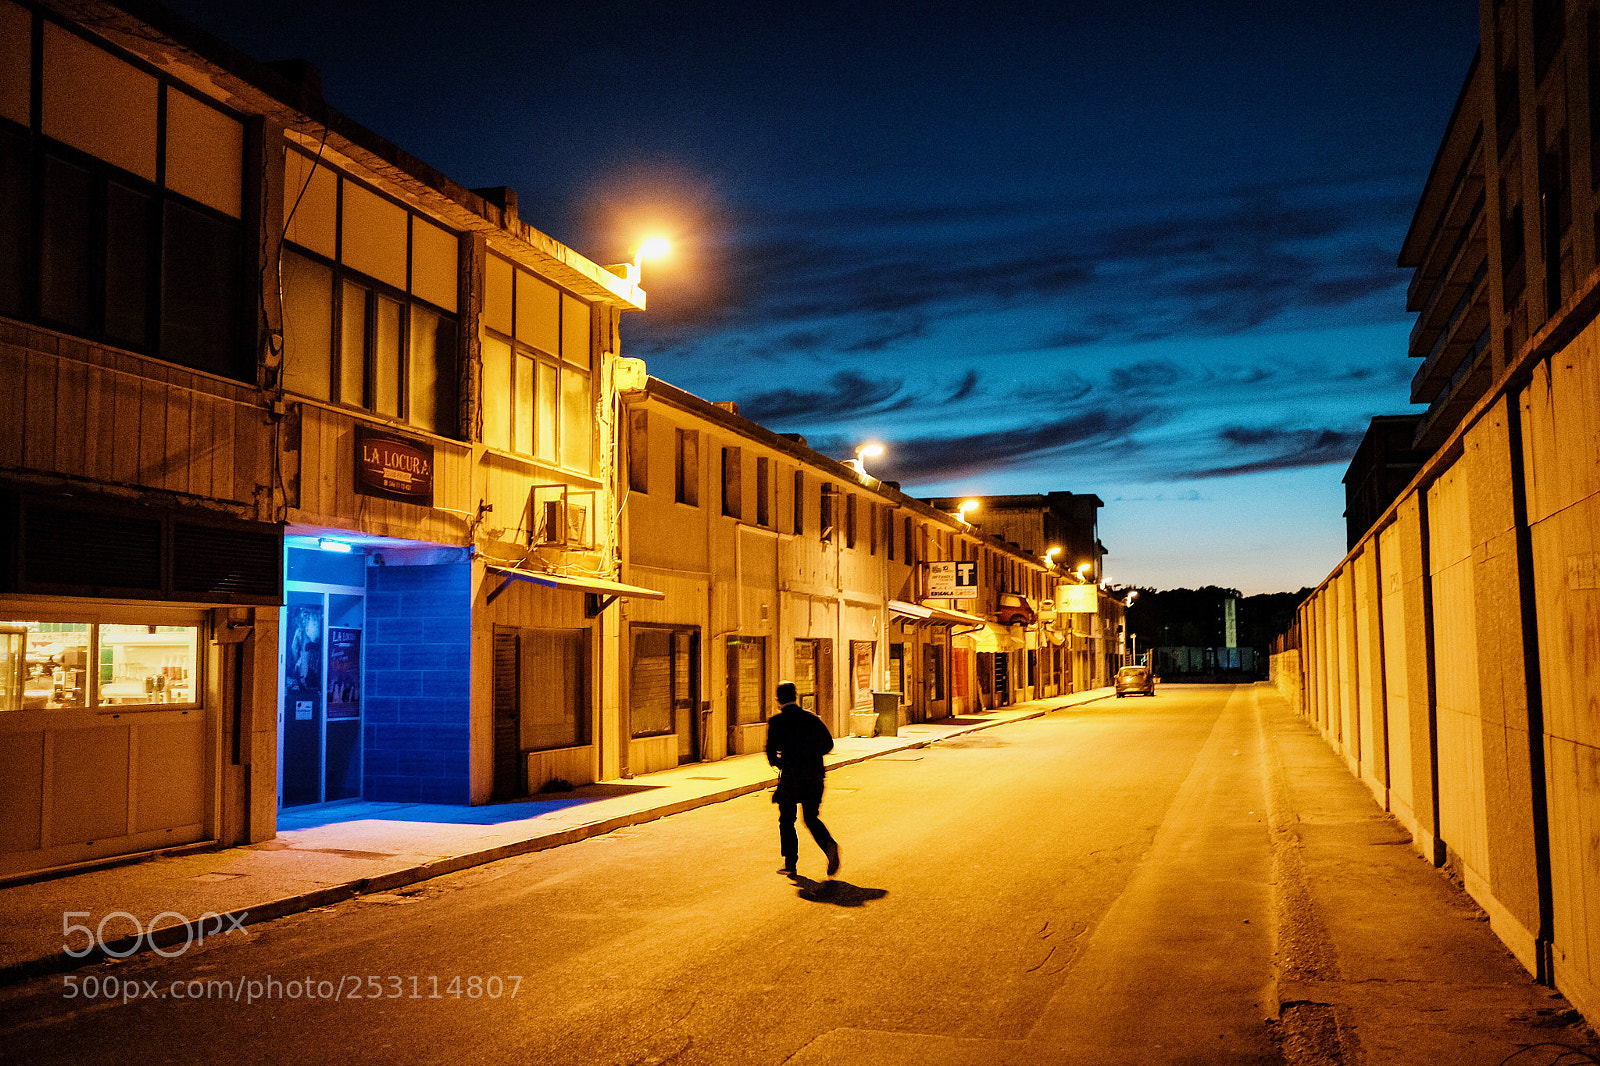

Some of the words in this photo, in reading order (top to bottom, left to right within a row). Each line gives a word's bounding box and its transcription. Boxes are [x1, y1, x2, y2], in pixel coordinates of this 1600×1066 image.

[363, 445, 380, 464] LA
[384, 450, 429, 476] LOCURA
[957, 563, 975, 586] T
